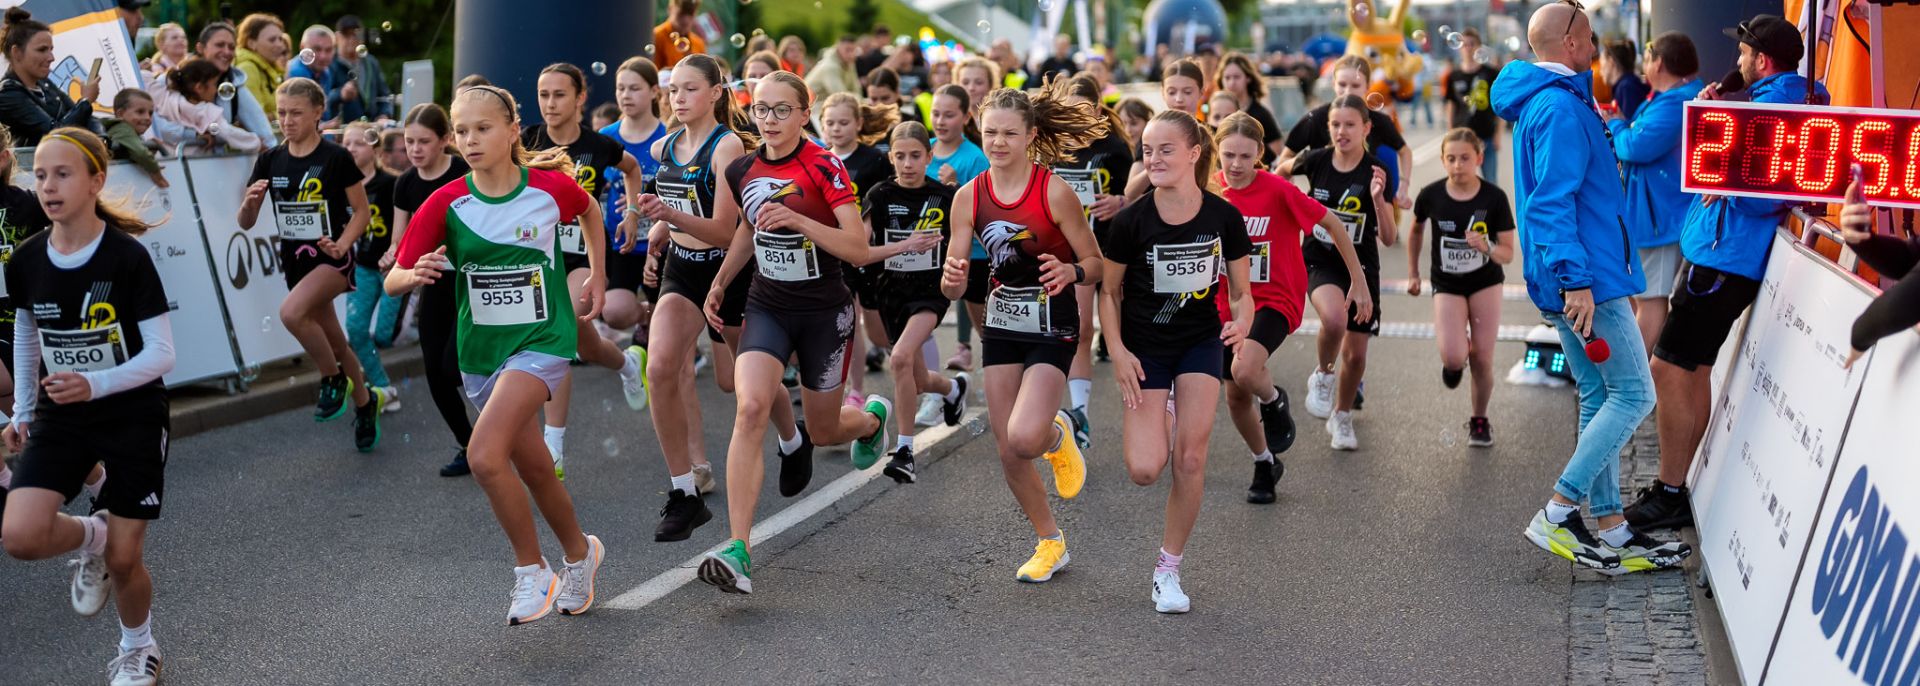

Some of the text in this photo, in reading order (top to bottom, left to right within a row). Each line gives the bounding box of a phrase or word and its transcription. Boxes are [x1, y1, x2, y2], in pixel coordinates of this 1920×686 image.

[285, 215, 314, 226] 8538
[558, 227, 574, 237] 34
[674, 247, 705, 262] NIKE
[765, 250, 796, 264] 8514
[1448, 250, 1478, 261] 8602
[1166, 260, 1206, 276] 9536
[481, 290, 524, 306] 9553
[996, 301, 1030, 317] 8524
[53, 348, 104, 365] 8560
